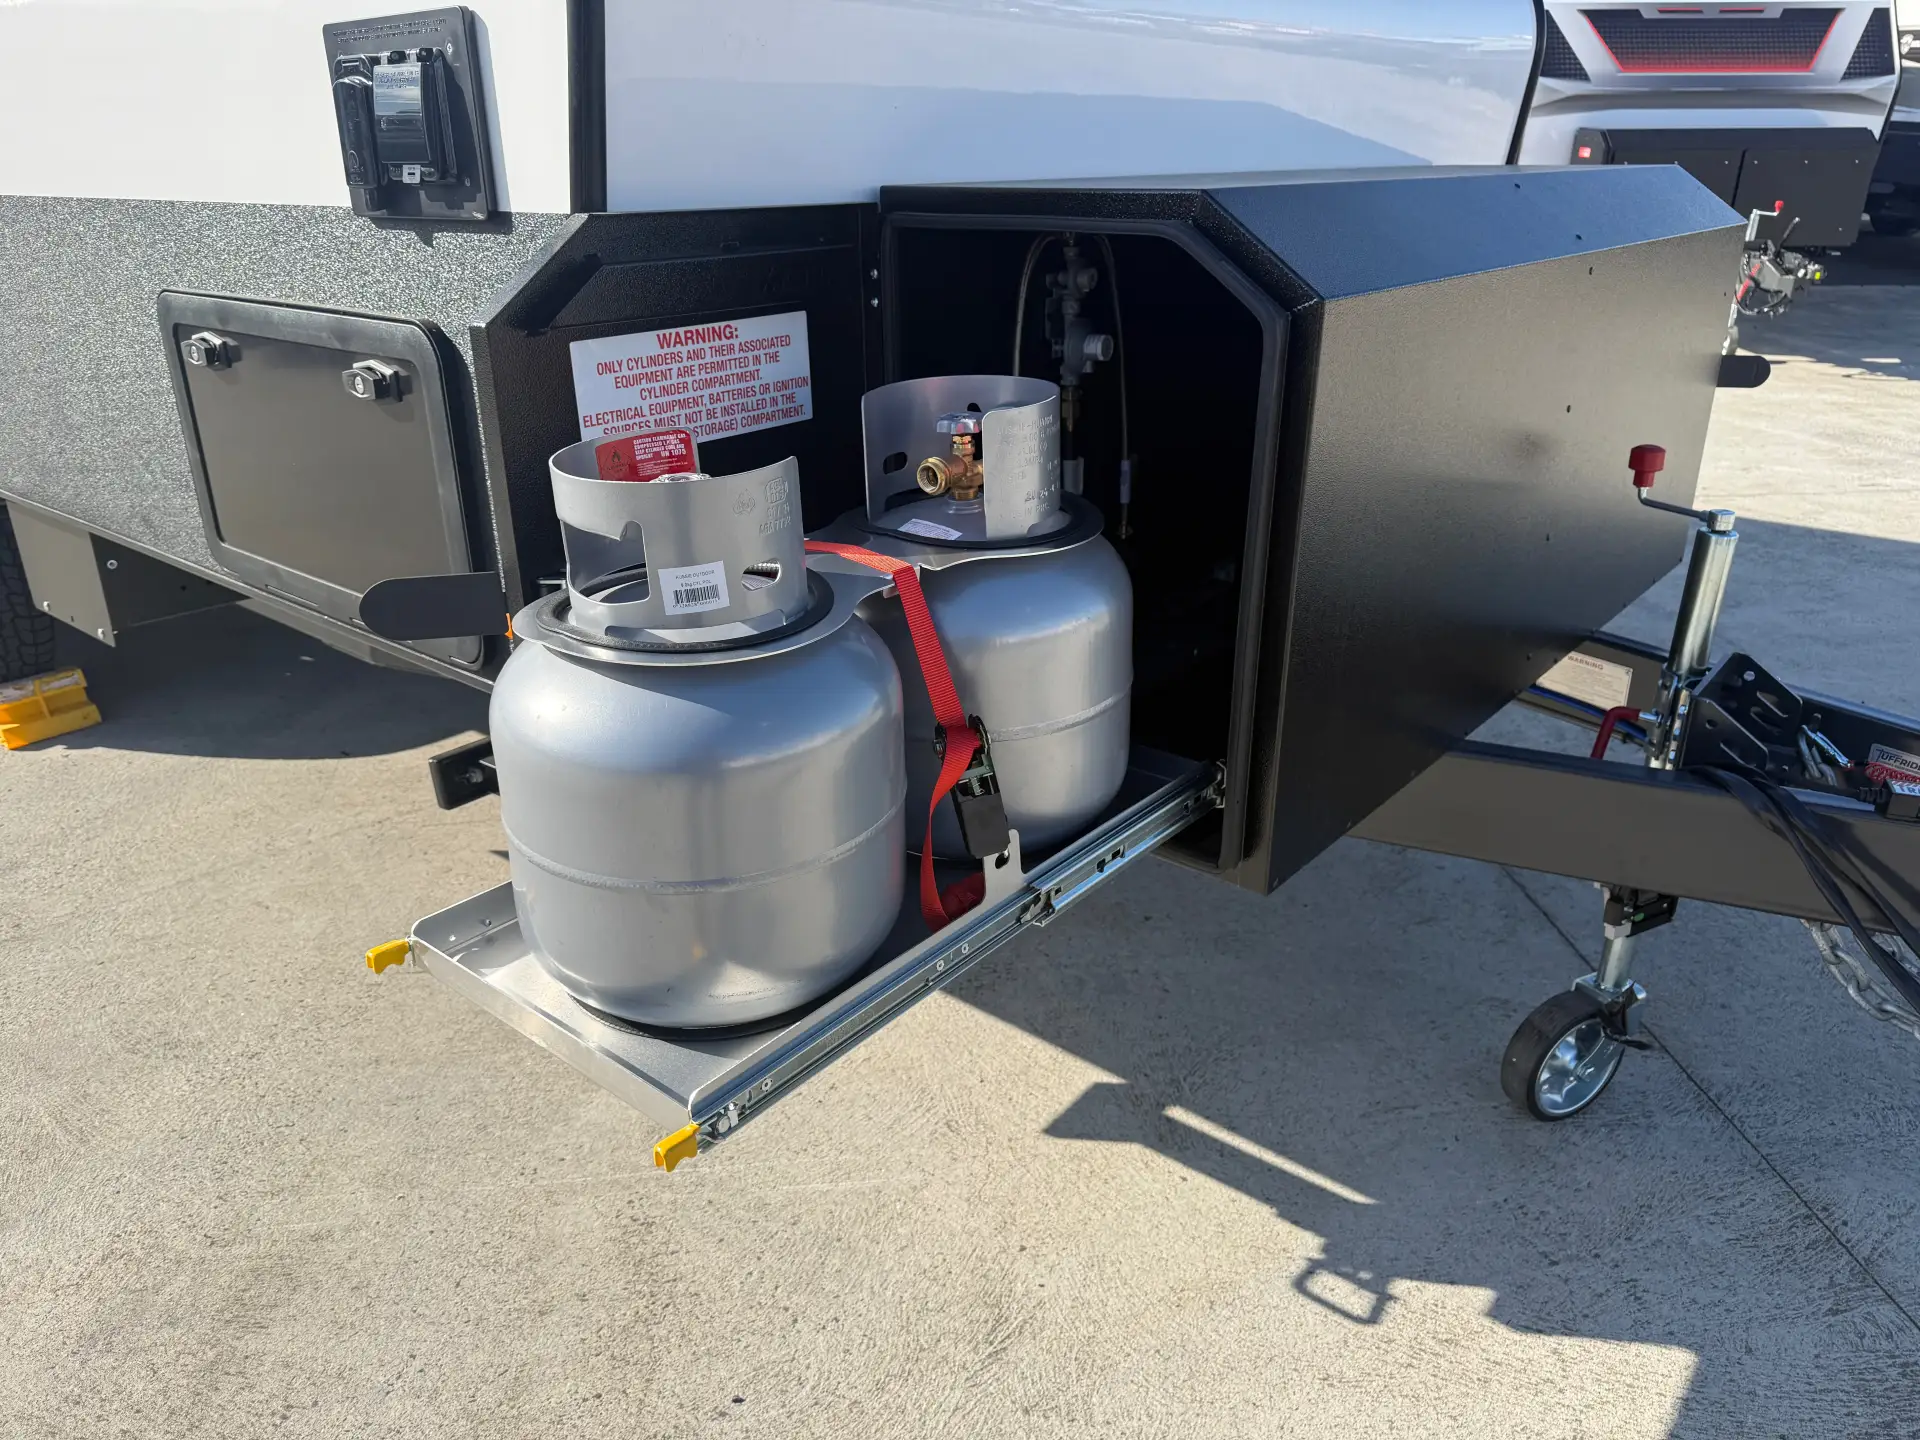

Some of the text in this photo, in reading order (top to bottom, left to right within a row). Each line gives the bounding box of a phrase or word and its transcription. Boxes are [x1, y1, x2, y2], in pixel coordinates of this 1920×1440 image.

[656, 324, 738, 350] WARNING:
[596, 335, 791, 376] ONLY CYLINDERS AND THEIR ASSOCIATED
[614, 351, 780, 389] EQUIPMENT ARE PERMITTED IN THE
[583, 376, 808, 428] ELECTRICAL EQUIPMENT, BATTERIES OR IGNITION
[640, 369, 762, 401] CYLINDER COMPARTMENT.
[603, 392, 796, 435] SOURCES MUST NOT BE INSTALLED IN THE
[693, 404, 806, 437] STORAGE) COMPARTMENT.
[1568, 655, 1604, 670] WARNING
